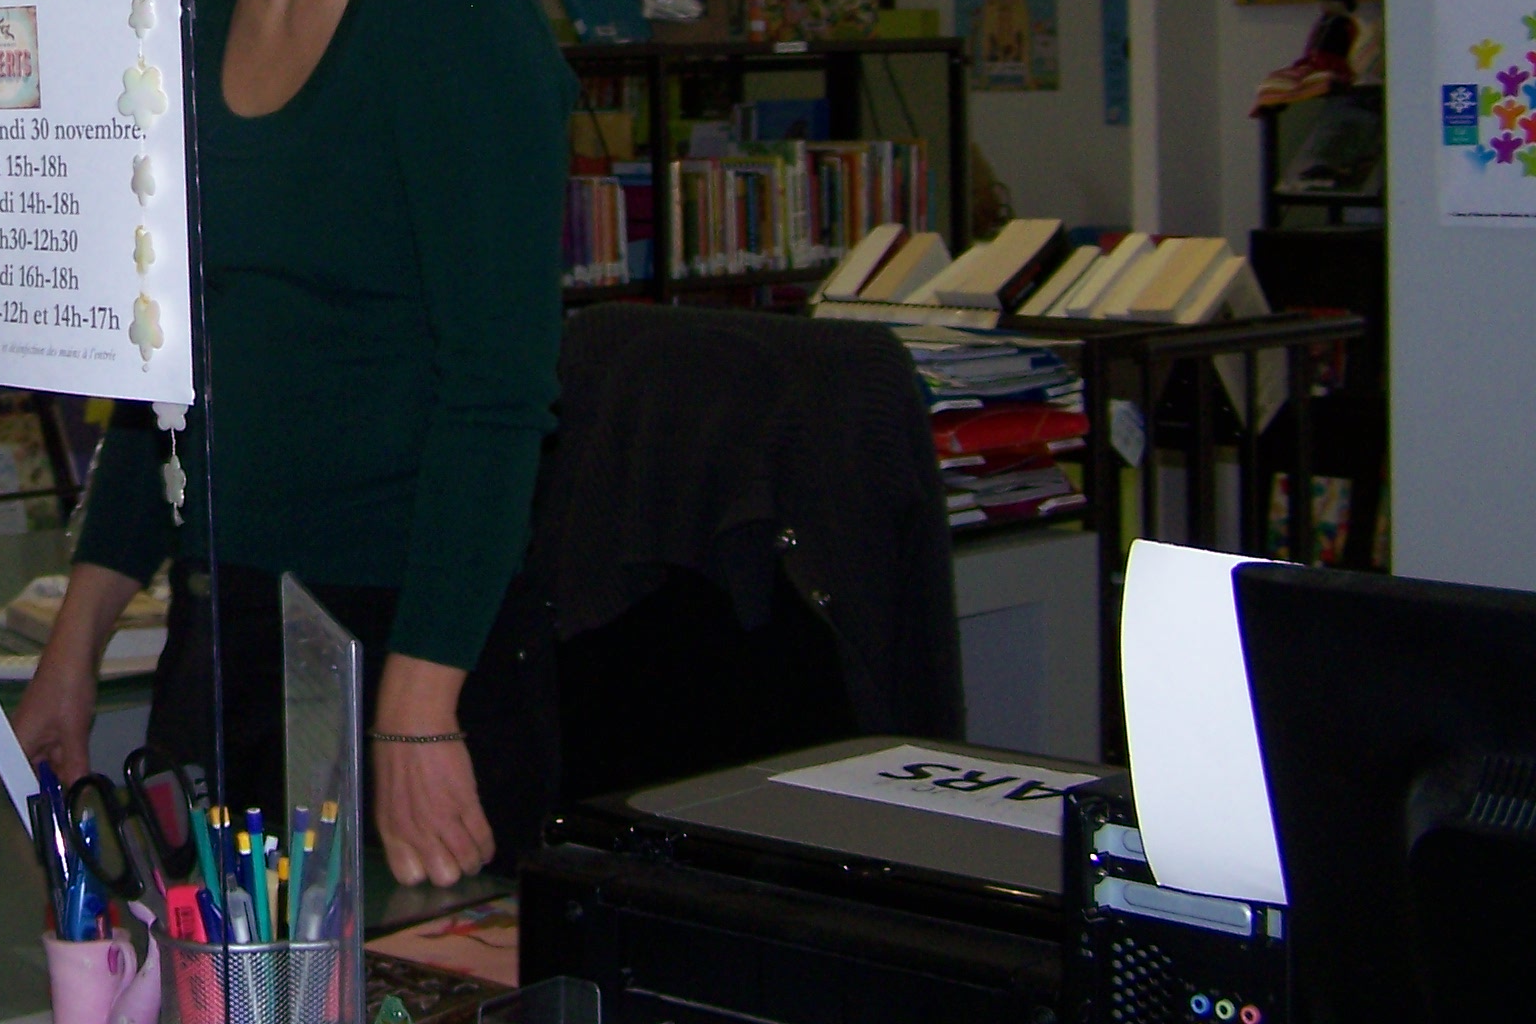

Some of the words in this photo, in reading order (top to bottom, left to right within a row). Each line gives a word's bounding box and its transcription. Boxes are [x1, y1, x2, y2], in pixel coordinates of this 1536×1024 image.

[31, 118, 50, 141] 30
[6, 154, 68, 178] 15h-18h
[19, 192, 80, 215] 14h-18h
[19, 264, 80, 291] 16h-18h
[33, 307, 49, 326] et
[53, 303, 121, 331] 14h-17h
